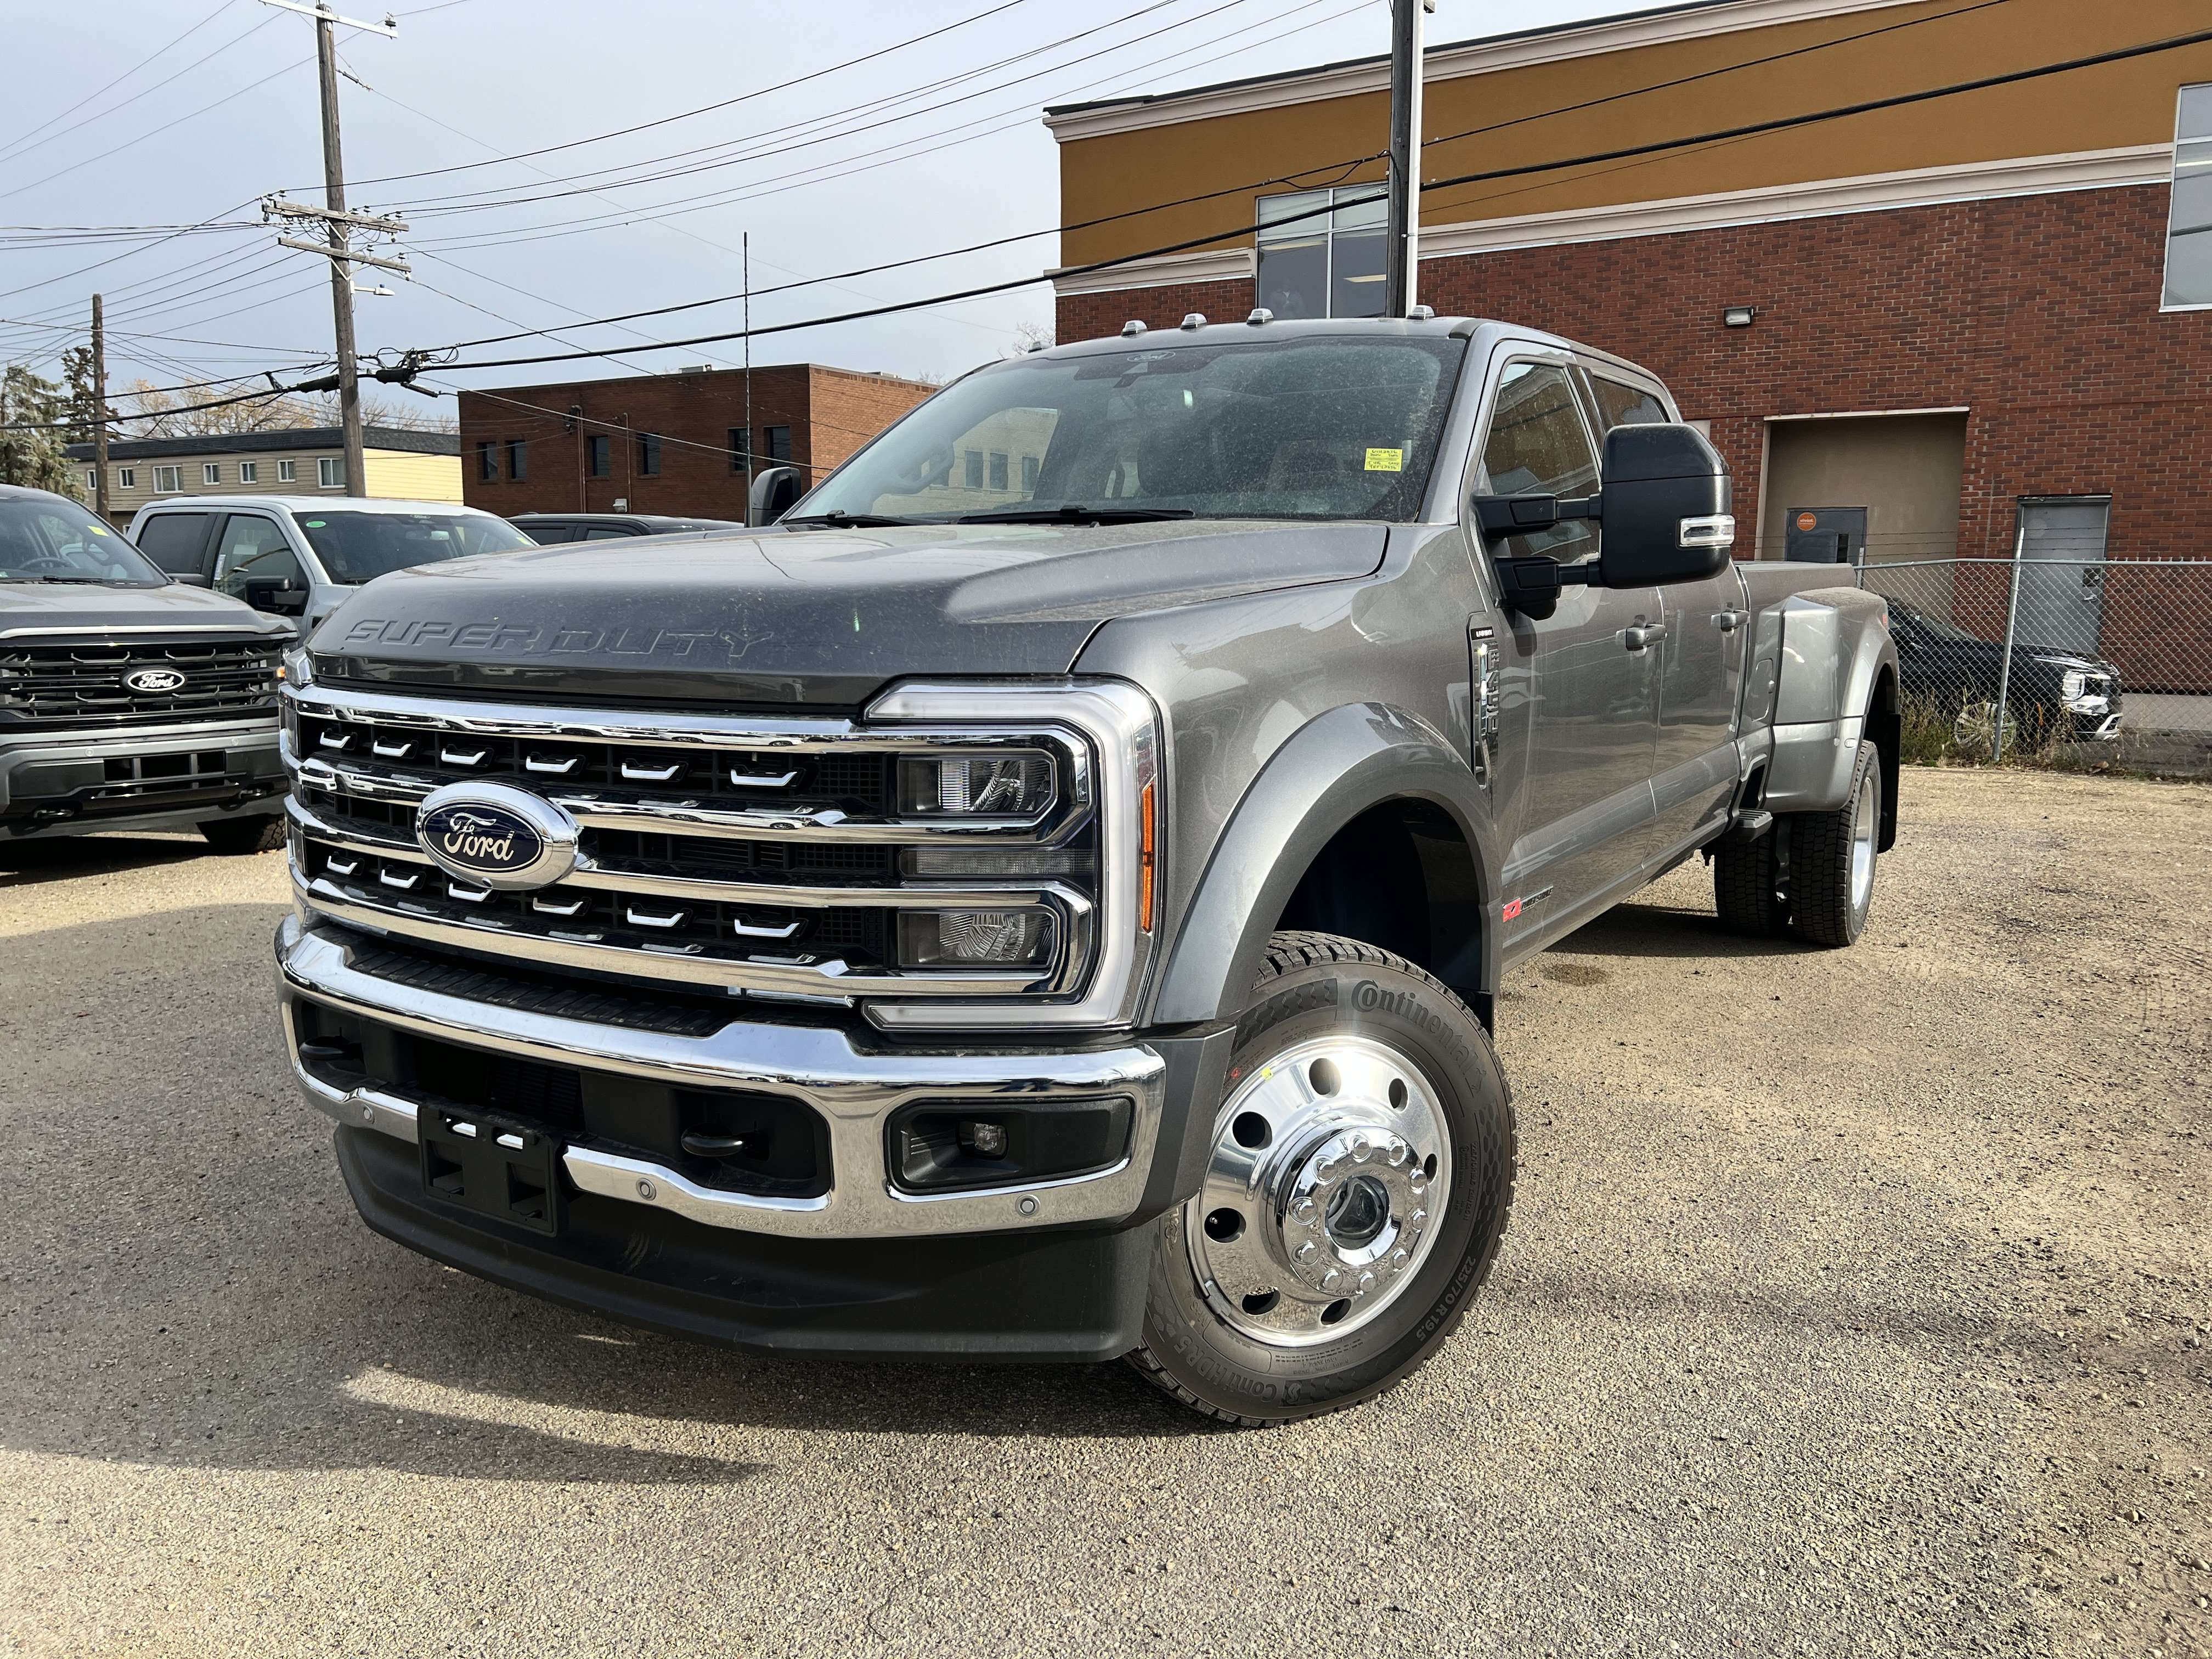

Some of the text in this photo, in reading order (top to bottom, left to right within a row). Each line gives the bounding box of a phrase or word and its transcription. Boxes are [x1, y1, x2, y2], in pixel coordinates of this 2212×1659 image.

[346, 620, 775, 657] SUPER DUTY
[139, 673, 174, 688] Ford
[444, 812, 515, 861] Ford
[1351, 980, 1480, 1076] Continental
[1445, 1256, 1476, 1305] 225/70
